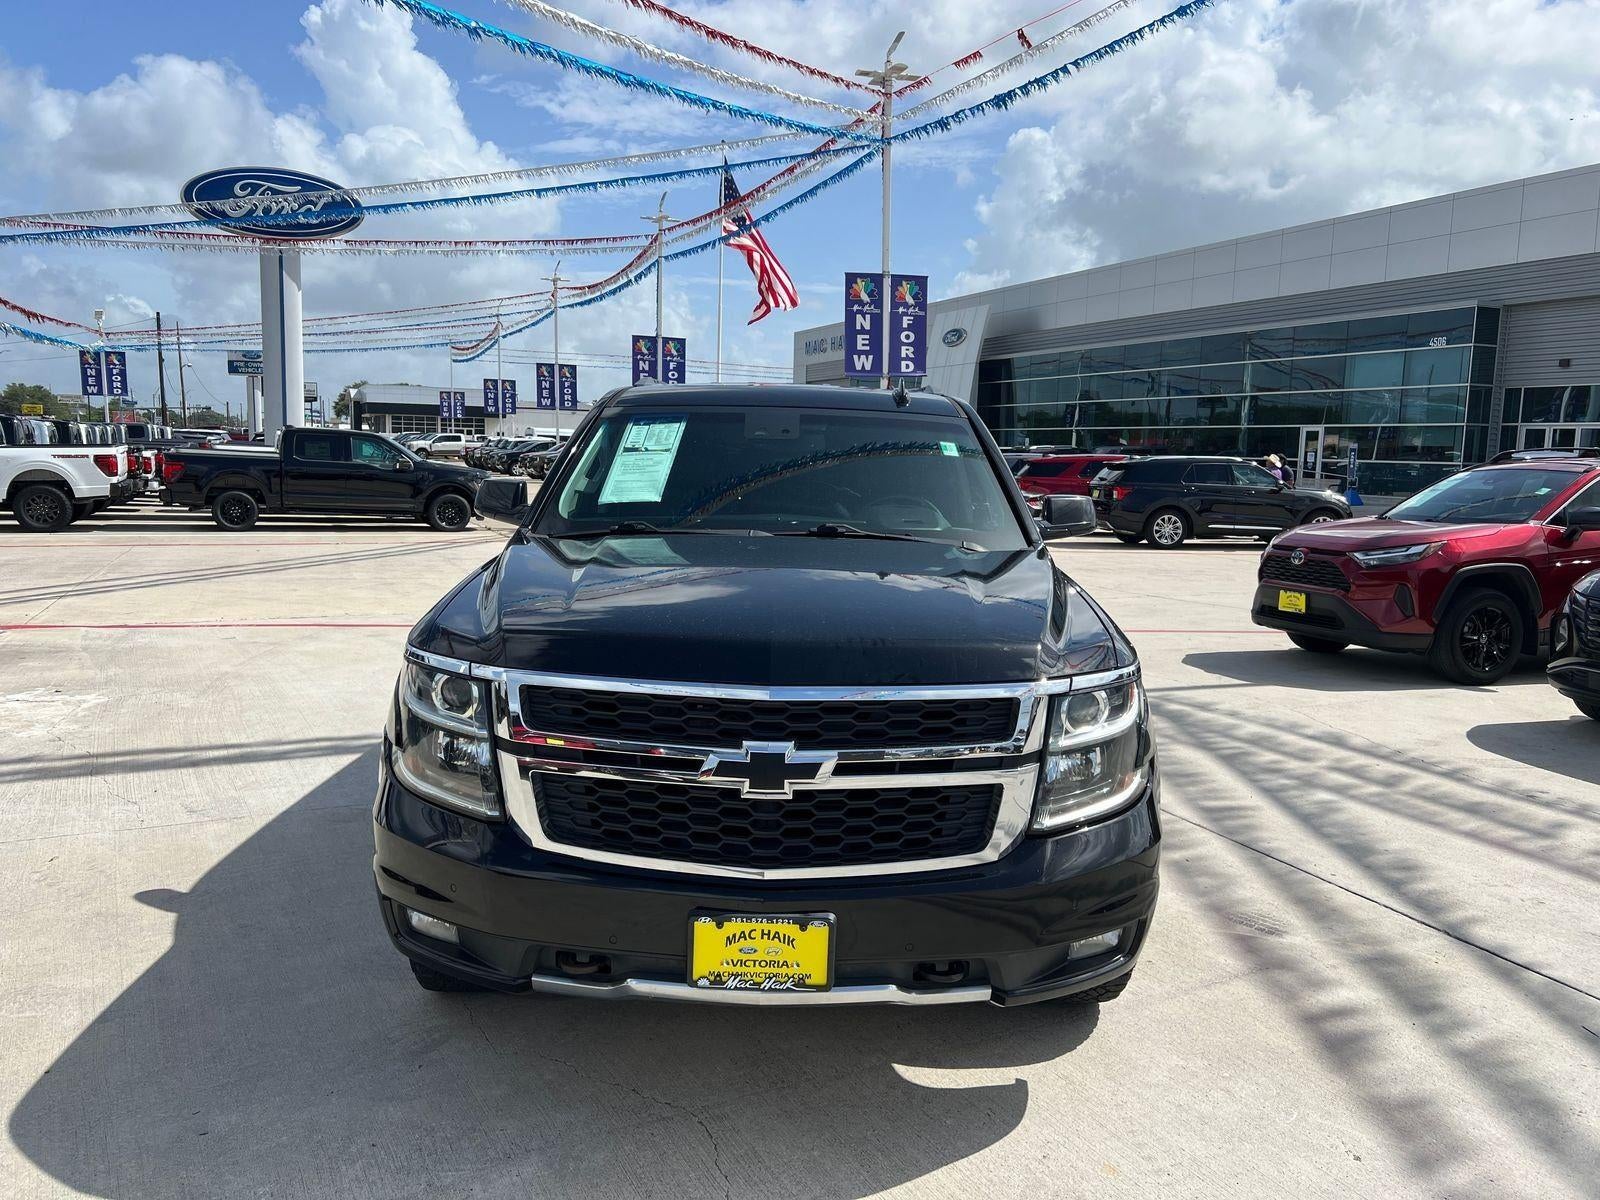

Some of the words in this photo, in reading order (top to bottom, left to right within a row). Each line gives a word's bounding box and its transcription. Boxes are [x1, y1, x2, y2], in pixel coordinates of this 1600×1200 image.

[804, 337, 828, 356] MAC
[830, 334, 845, 352] HA
[852, 313, 874, 371] NEW
[900, 316, 916, 373] FORD
[1429, 336, 1447, 347] 4506
[86, 368, 98, 394] NEW
[111, 368, 122, 395] FORD
[541, 380, 551, 406] NEW
[487, 392, 496, 413] NEW
[563, 381, 573, 407] FORD
[725, 929, 757, 948] MAC
[760, 929, 797, 950] HAIK
[730, 958, 790, 969] VICTORIA
[722, 975, 760, 990] Mac
[760, 976, 812, 991] Haik
